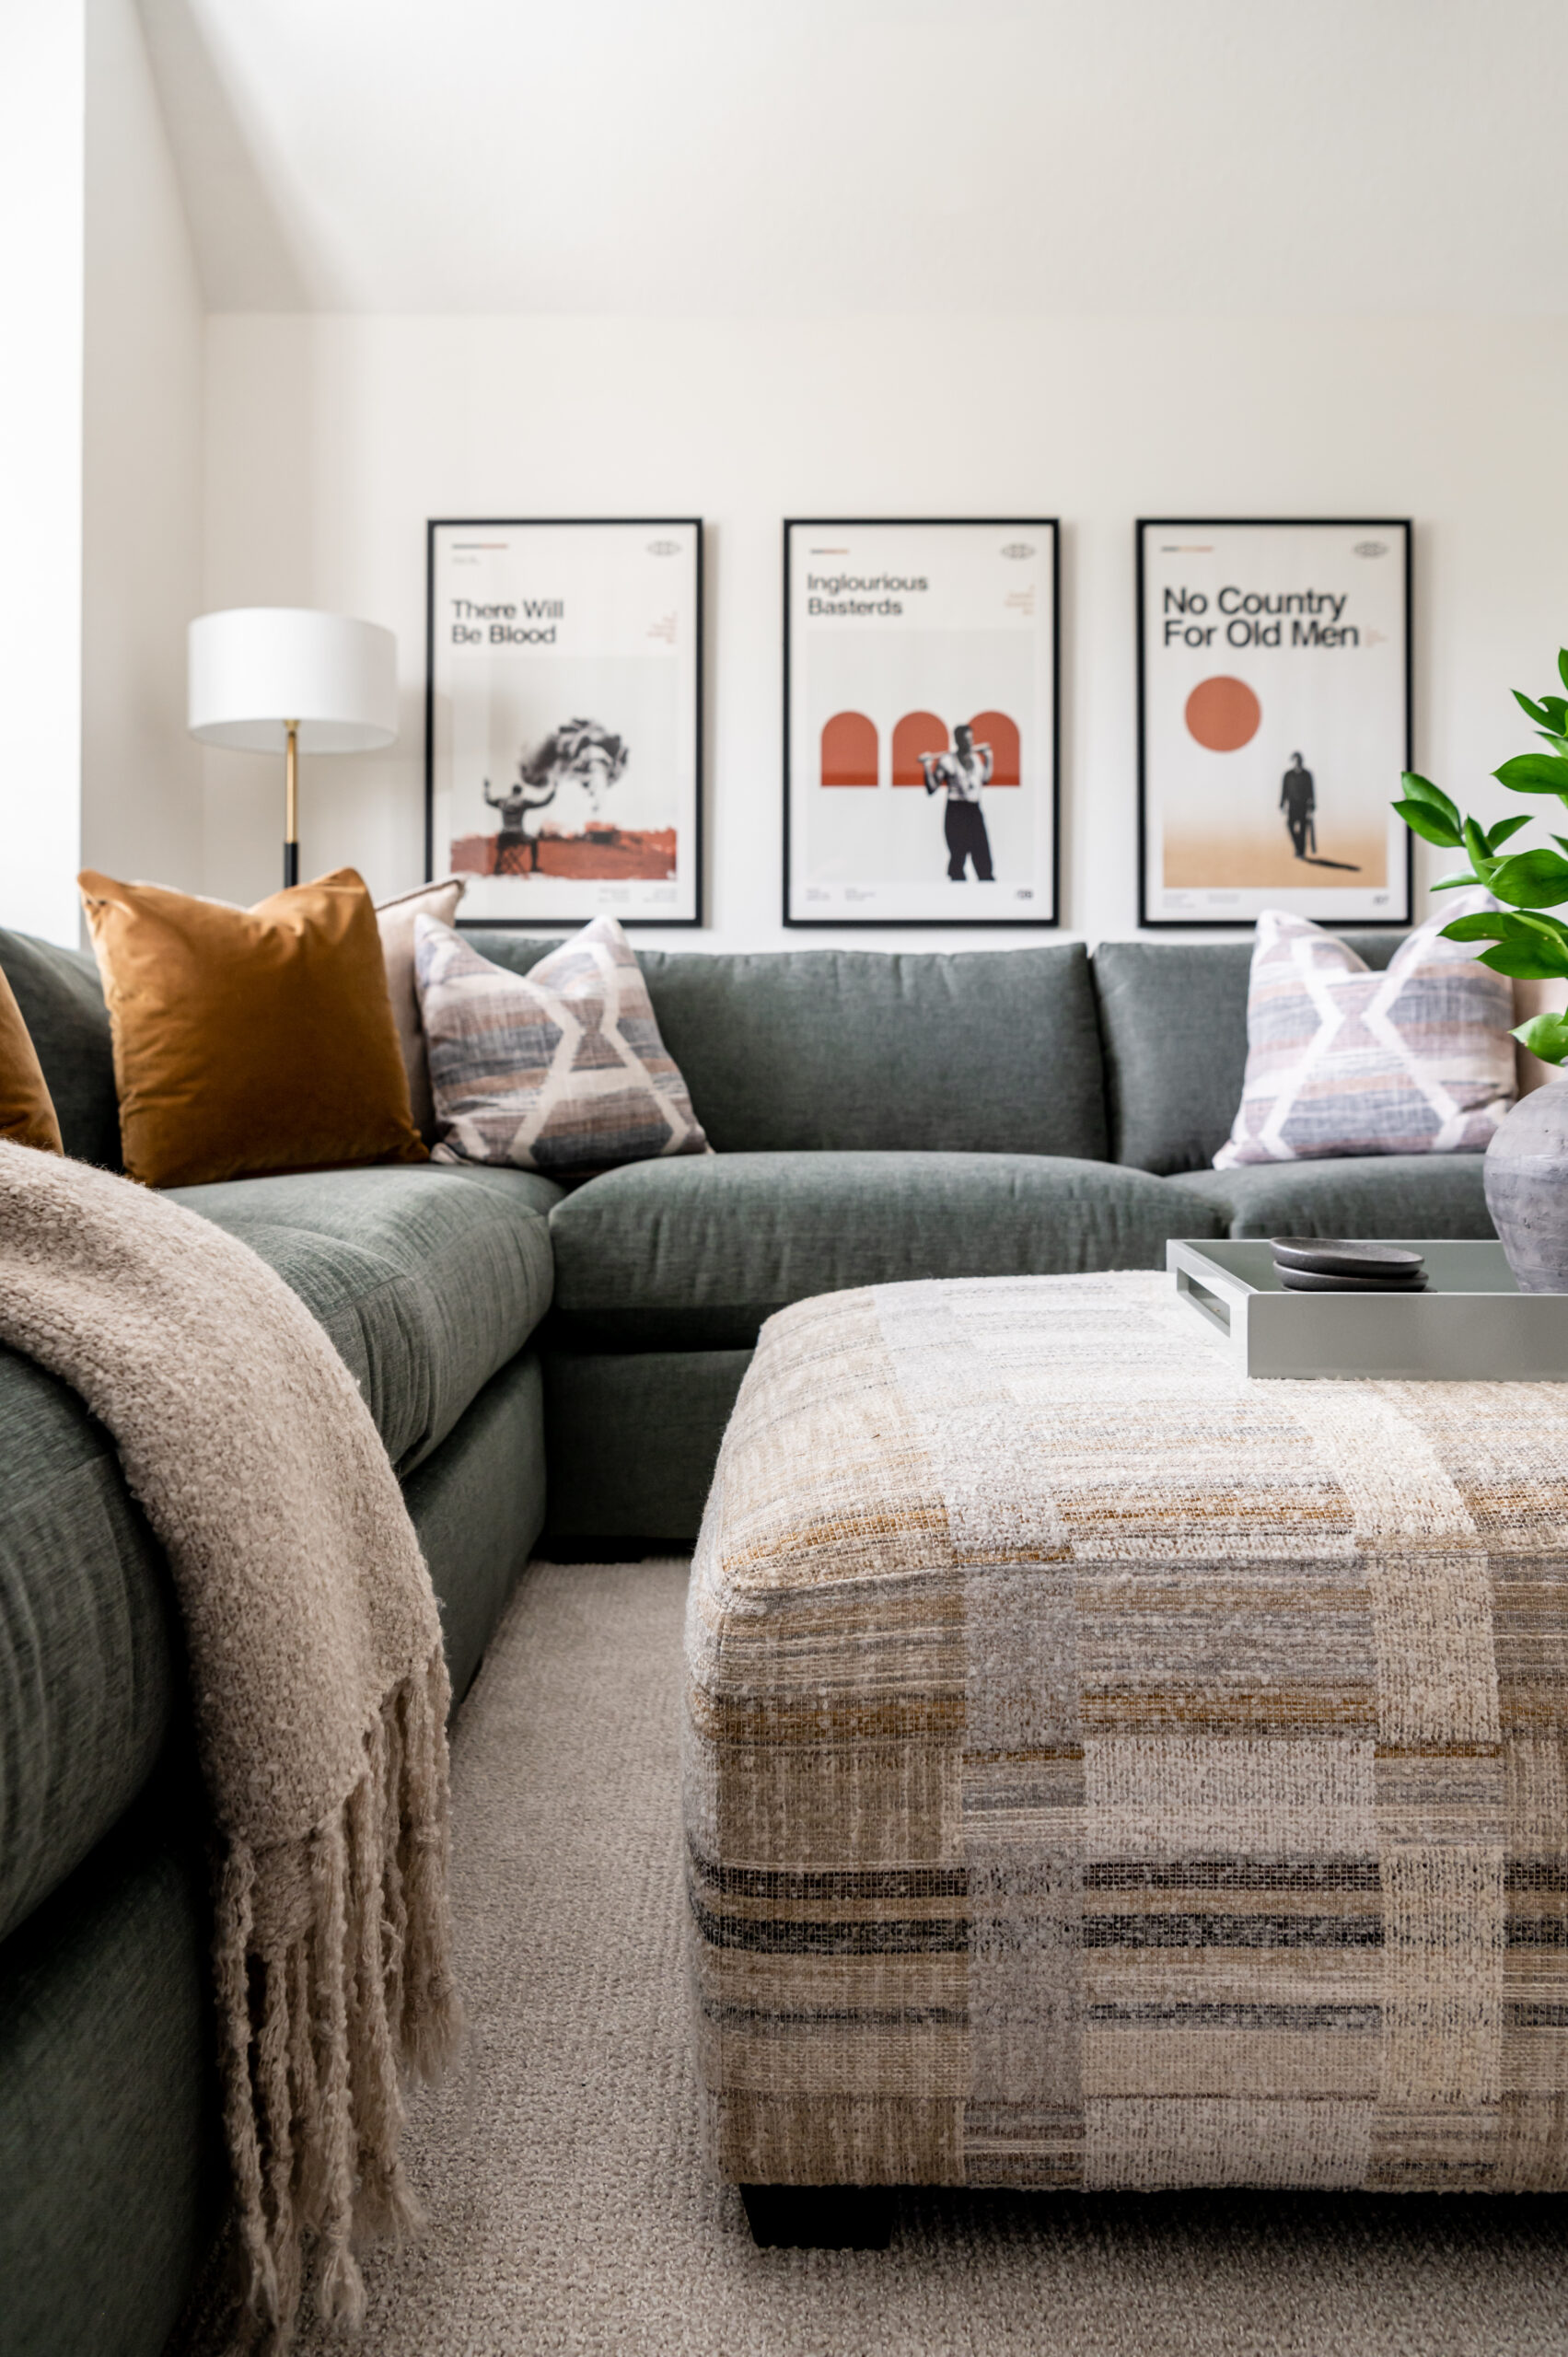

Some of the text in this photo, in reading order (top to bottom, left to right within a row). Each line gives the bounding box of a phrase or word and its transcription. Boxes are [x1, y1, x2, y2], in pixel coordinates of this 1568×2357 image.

[807, 574, 930, 597] Inglourious
[451, 599, 564, 620] There Will
[807, 597, 903, 616] Basterds
[1163, 586, 1348, 622] No Country
[451, 623, 556, 645] Be Blood
[1163, 619, 1218, 648] For
[1226, 619, 1282, 648] Old
[1291, 618, 1360, 648] Men
